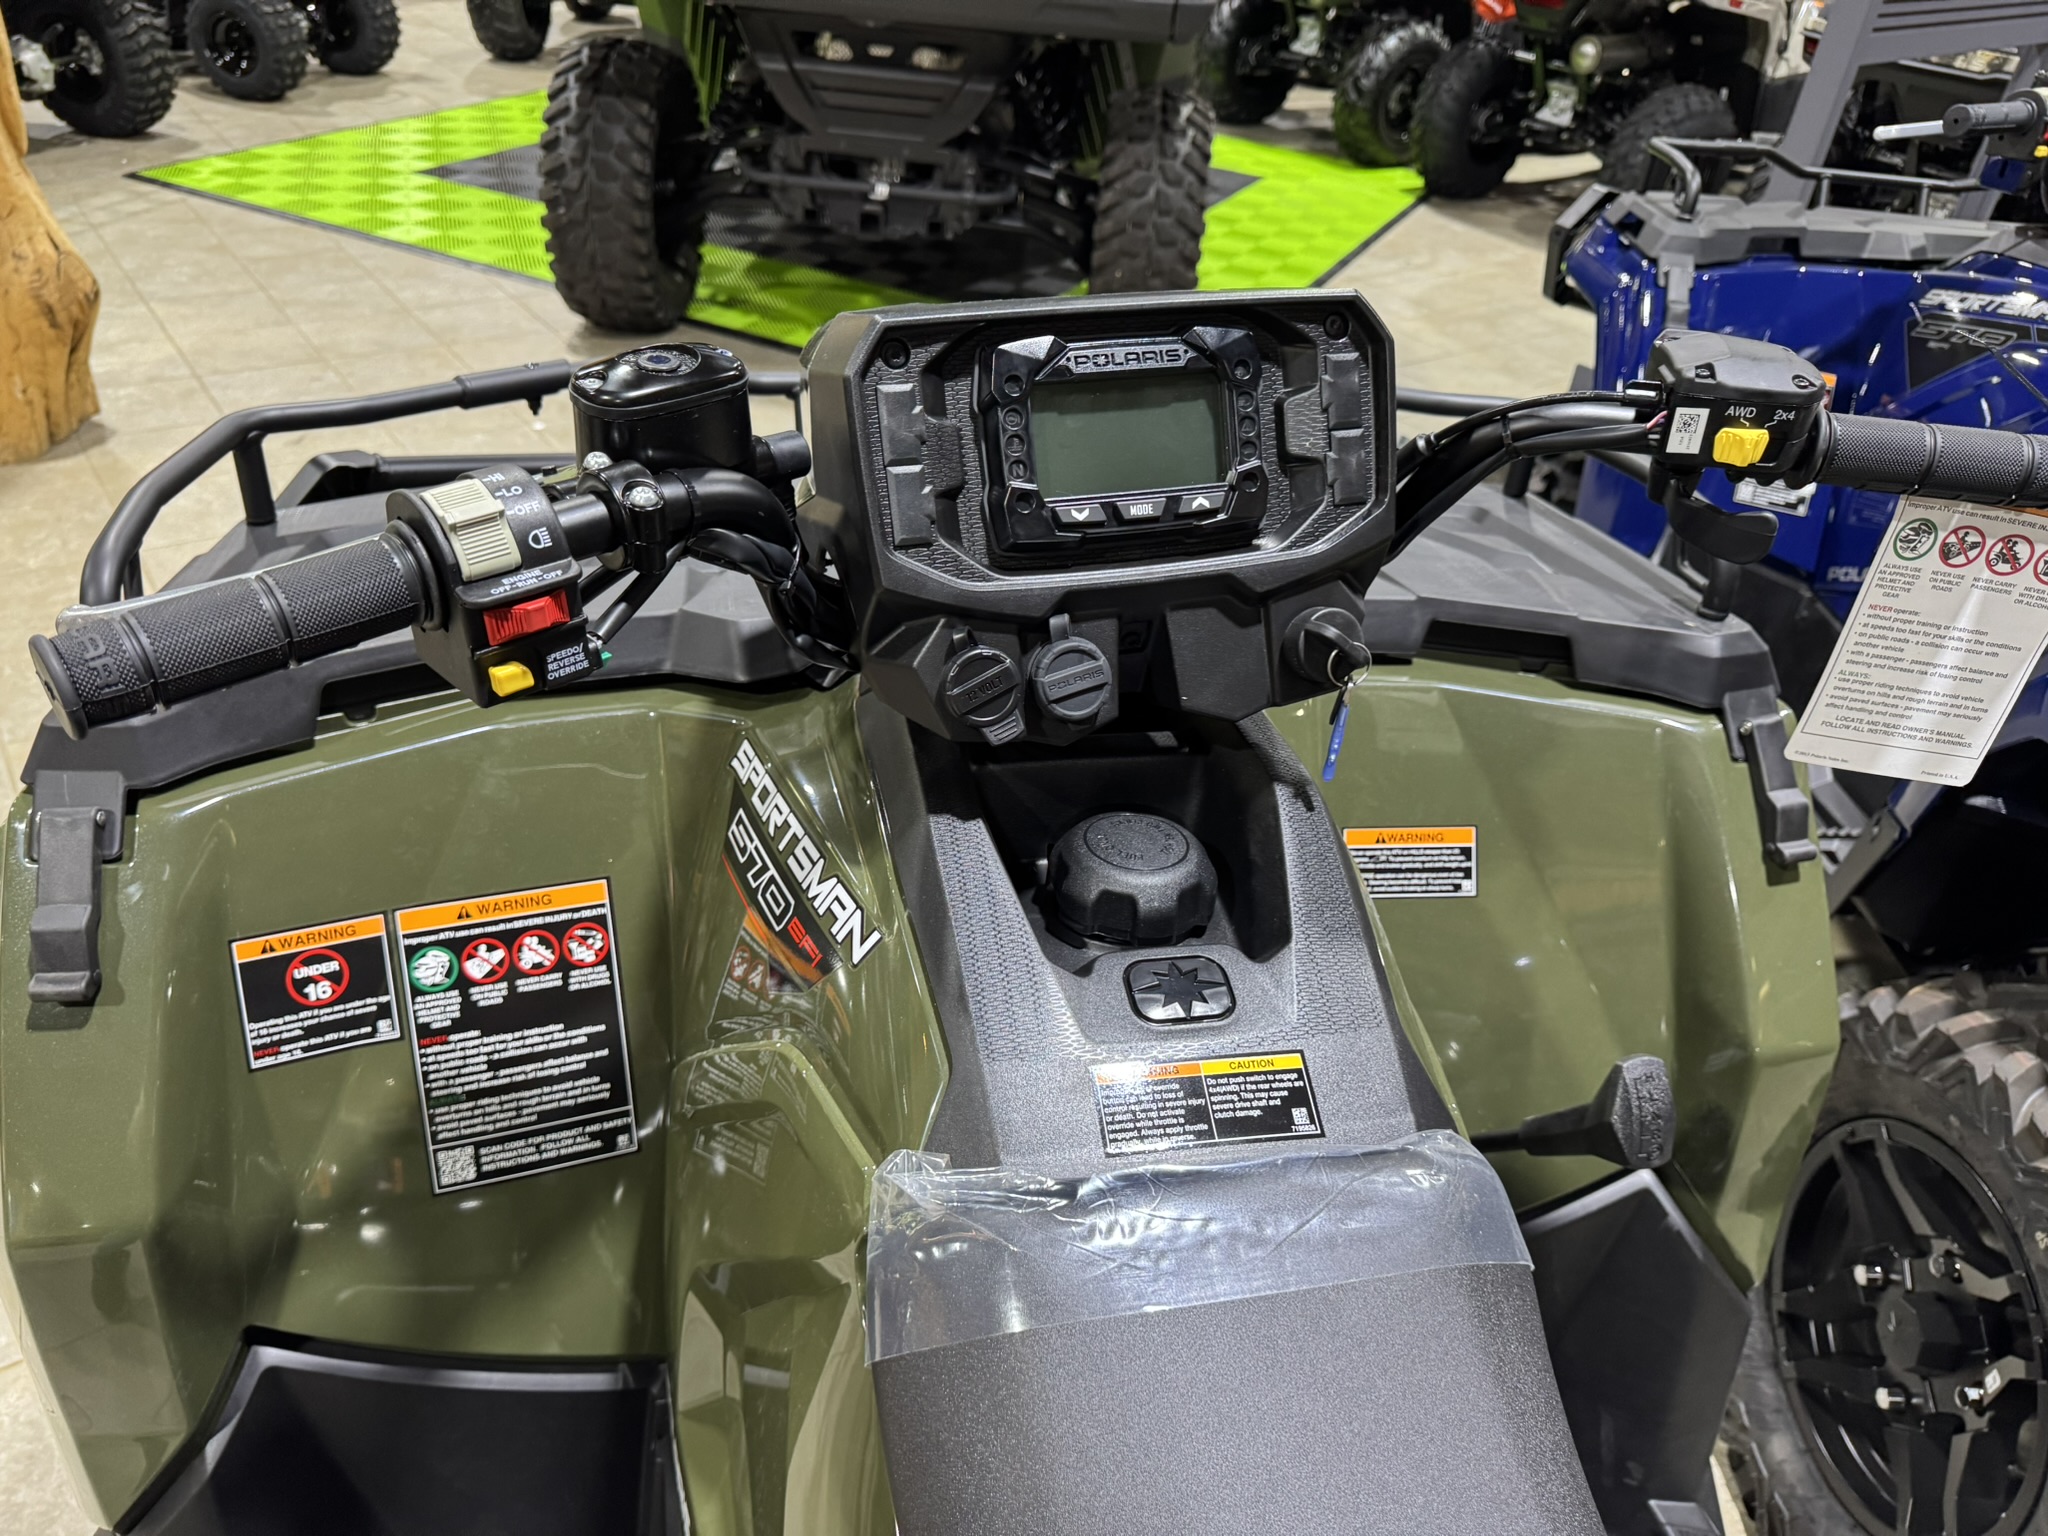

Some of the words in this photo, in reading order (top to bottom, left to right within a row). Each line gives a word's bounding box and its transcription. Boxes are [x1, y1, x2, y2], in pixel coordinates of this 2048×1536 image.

[1073, 349, 1182, 368] POLARIS
[1725, 406, 1757, 418] AWD
[1773, 410, 1796, 421] 2x4
[514, 502, 541, 516] OFF
[1130, 504, 1154, 516] MODE
[2006, 518, 2038, 528] SEVERE
[502, 570, 543, 586] ENGINE
[1877, 576, 1901, 584] HELMET
[1887, 570, 1920, 580] APPROVED
[1874, 582, 1911, 593] PROTECTIVE
[1970, 584, 2012, 594] PASSENGERS
[1868, 604, 1893, 612] NEVER
[546, 642, 584, 663] SPEEDO/
[548, 652, 586, 672] REVERSE
[548, 660, 590, 680] OVERRIDE
[1048, 668, 1105, 692] POLARIS
[966, 690, 977, 704] 12
[979, 676, 1004, 697] VOLT
[1835, 715, 1864, 723] LOCATE
[1820, 721, 1851, 729] FOLLOW
[1866, 728, 1917, 739] INSTRUCTIONS
[1386, 832, 1444, 843] WARNING
[730, 738, 884, 966] SPORTSMAN
[728, 807, 795, 932] 570
[476, 893, 552, 915] WARNING
[278, 924, 356, 949] WARNING
[788, 916, 823, 968] EFI
[292, 959, 340, 979] UNDER
[302, 979, 334, 1002] 16
[1228, 1058, 1274, 1070] CAUTION
[1228, 1076, 1245, 1084] push
[1187, 1098, 1206, 1106] injury
[1209, 1093, 1240, 1103] spinning.
[1159, 1108, 1185, 1116] activate
[1234, 1108, 1263, 1118] damage.
[1107, 1121, 1134, 1130] override
[1135, 1119, 1153, 1127] while
[1153, 1117, 1177, 1126] throttle
[1140, 1127, 1164, 1137] Always
[1164, 1125, 1184, 1134] apply
[1184, 1123, 1208, 1131] throttle
[478, 1143, 502, 1155] SCAN
[503, 1138, 526, 1150] CODE
[527, 1134, 544, 1144] FOR
[545, 1126, 583, 1141] PRODUCT
[583, 1122, 602, 1132] AND
[602, 1116, 631, 1128] SAFETY
[539, 1137, 574, 1152] FOLLOW
[574, 1133, 591, 1144] ALL
[480, 1152, 540, 1173] INSTRUCTIONS
[540, 1148, 558, 1159] AND
